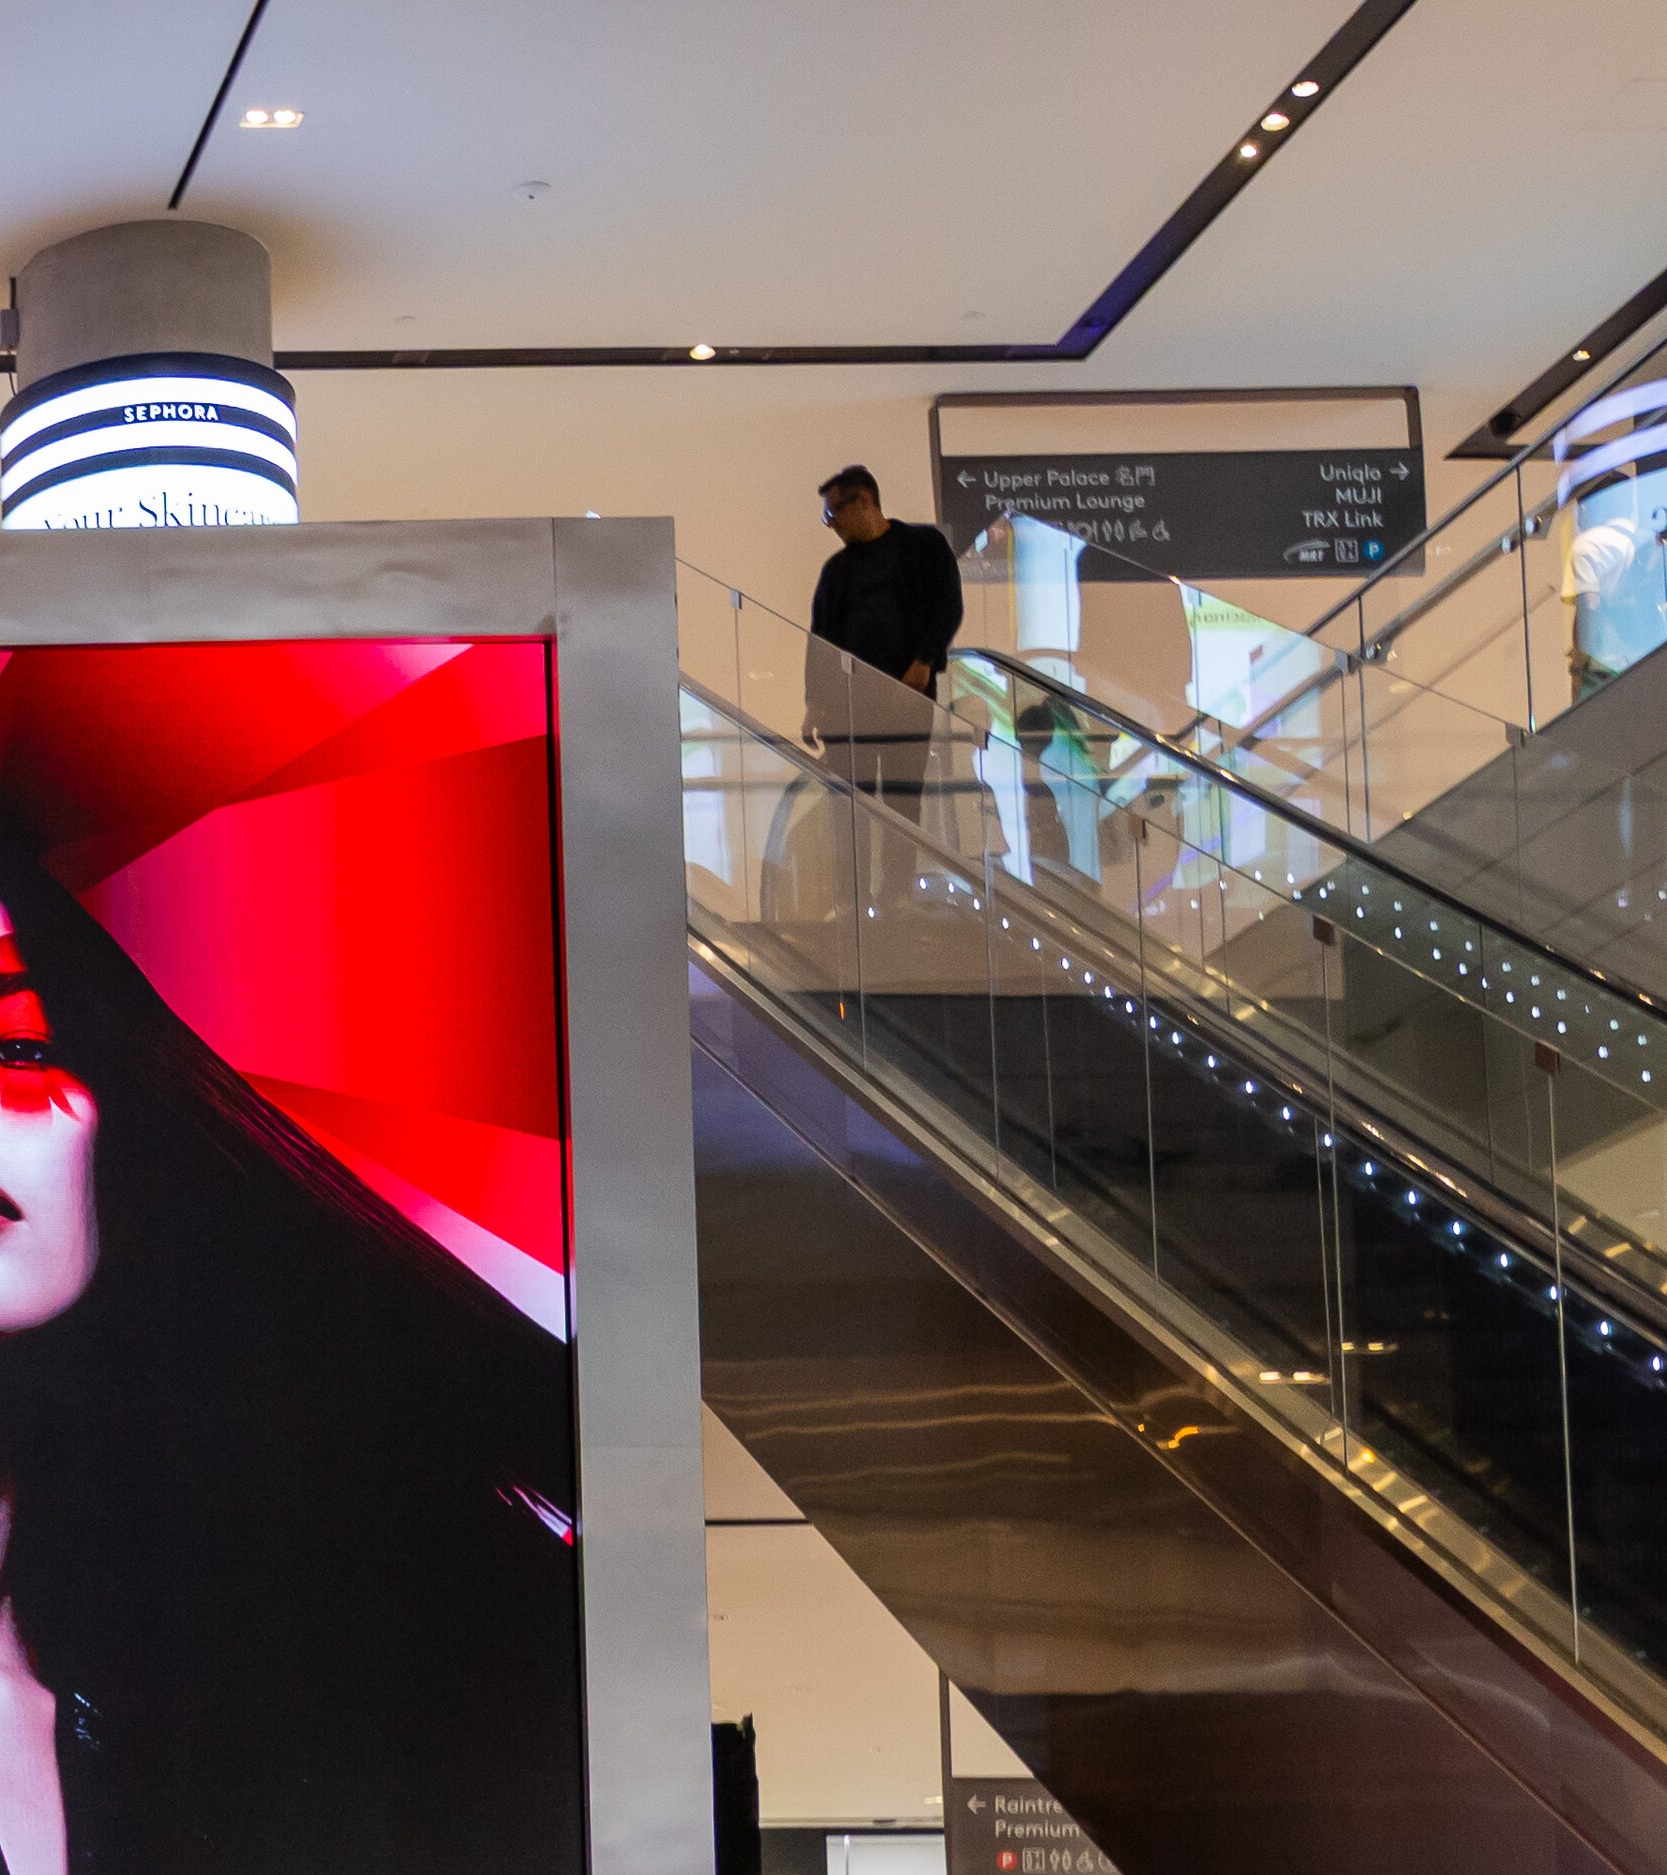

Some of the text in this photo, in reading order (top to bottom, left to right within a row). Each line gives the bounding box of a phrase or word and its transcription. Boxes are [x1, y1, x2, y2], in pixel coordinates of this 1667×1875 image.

[123, 403, 218, 423] SEPHORA
[984, 469, 1041, 492] Upper
[1047, 468, 1110, 488] Palace
[1319, 463, 1382, 485] Uniqlo
[984, 491, 1146, 512] Premium Lounge
[1335, 486, 1382, 504] MUJI
[1301, 509, 1384, 528] TRX Link
[994, 1819, 1081, 1838] Premium
